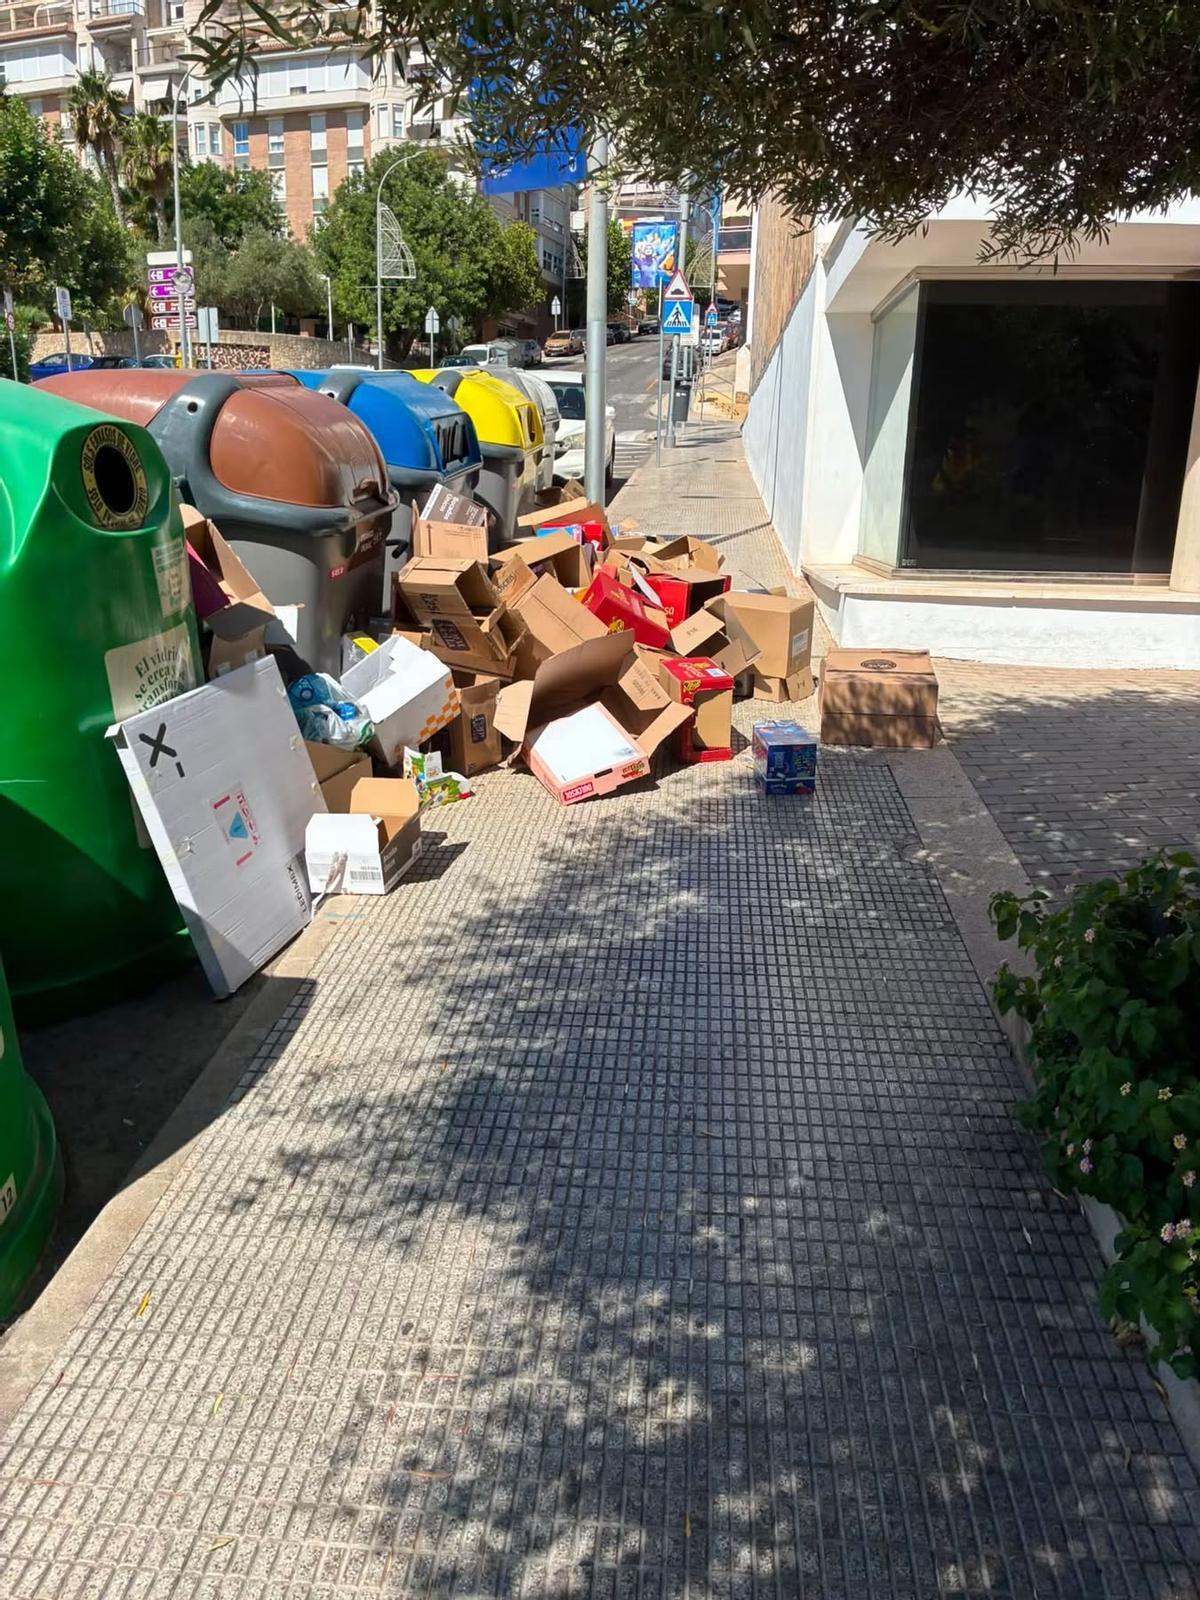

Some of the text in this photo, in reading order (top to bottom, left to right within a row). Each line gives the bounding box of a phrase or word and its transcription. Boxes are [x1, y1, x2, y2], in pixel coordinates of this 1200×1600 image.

[135, 645, 179, 679] El vidri
[134, 683, 148, 702] se
[147, 664, 171, 686] crea
